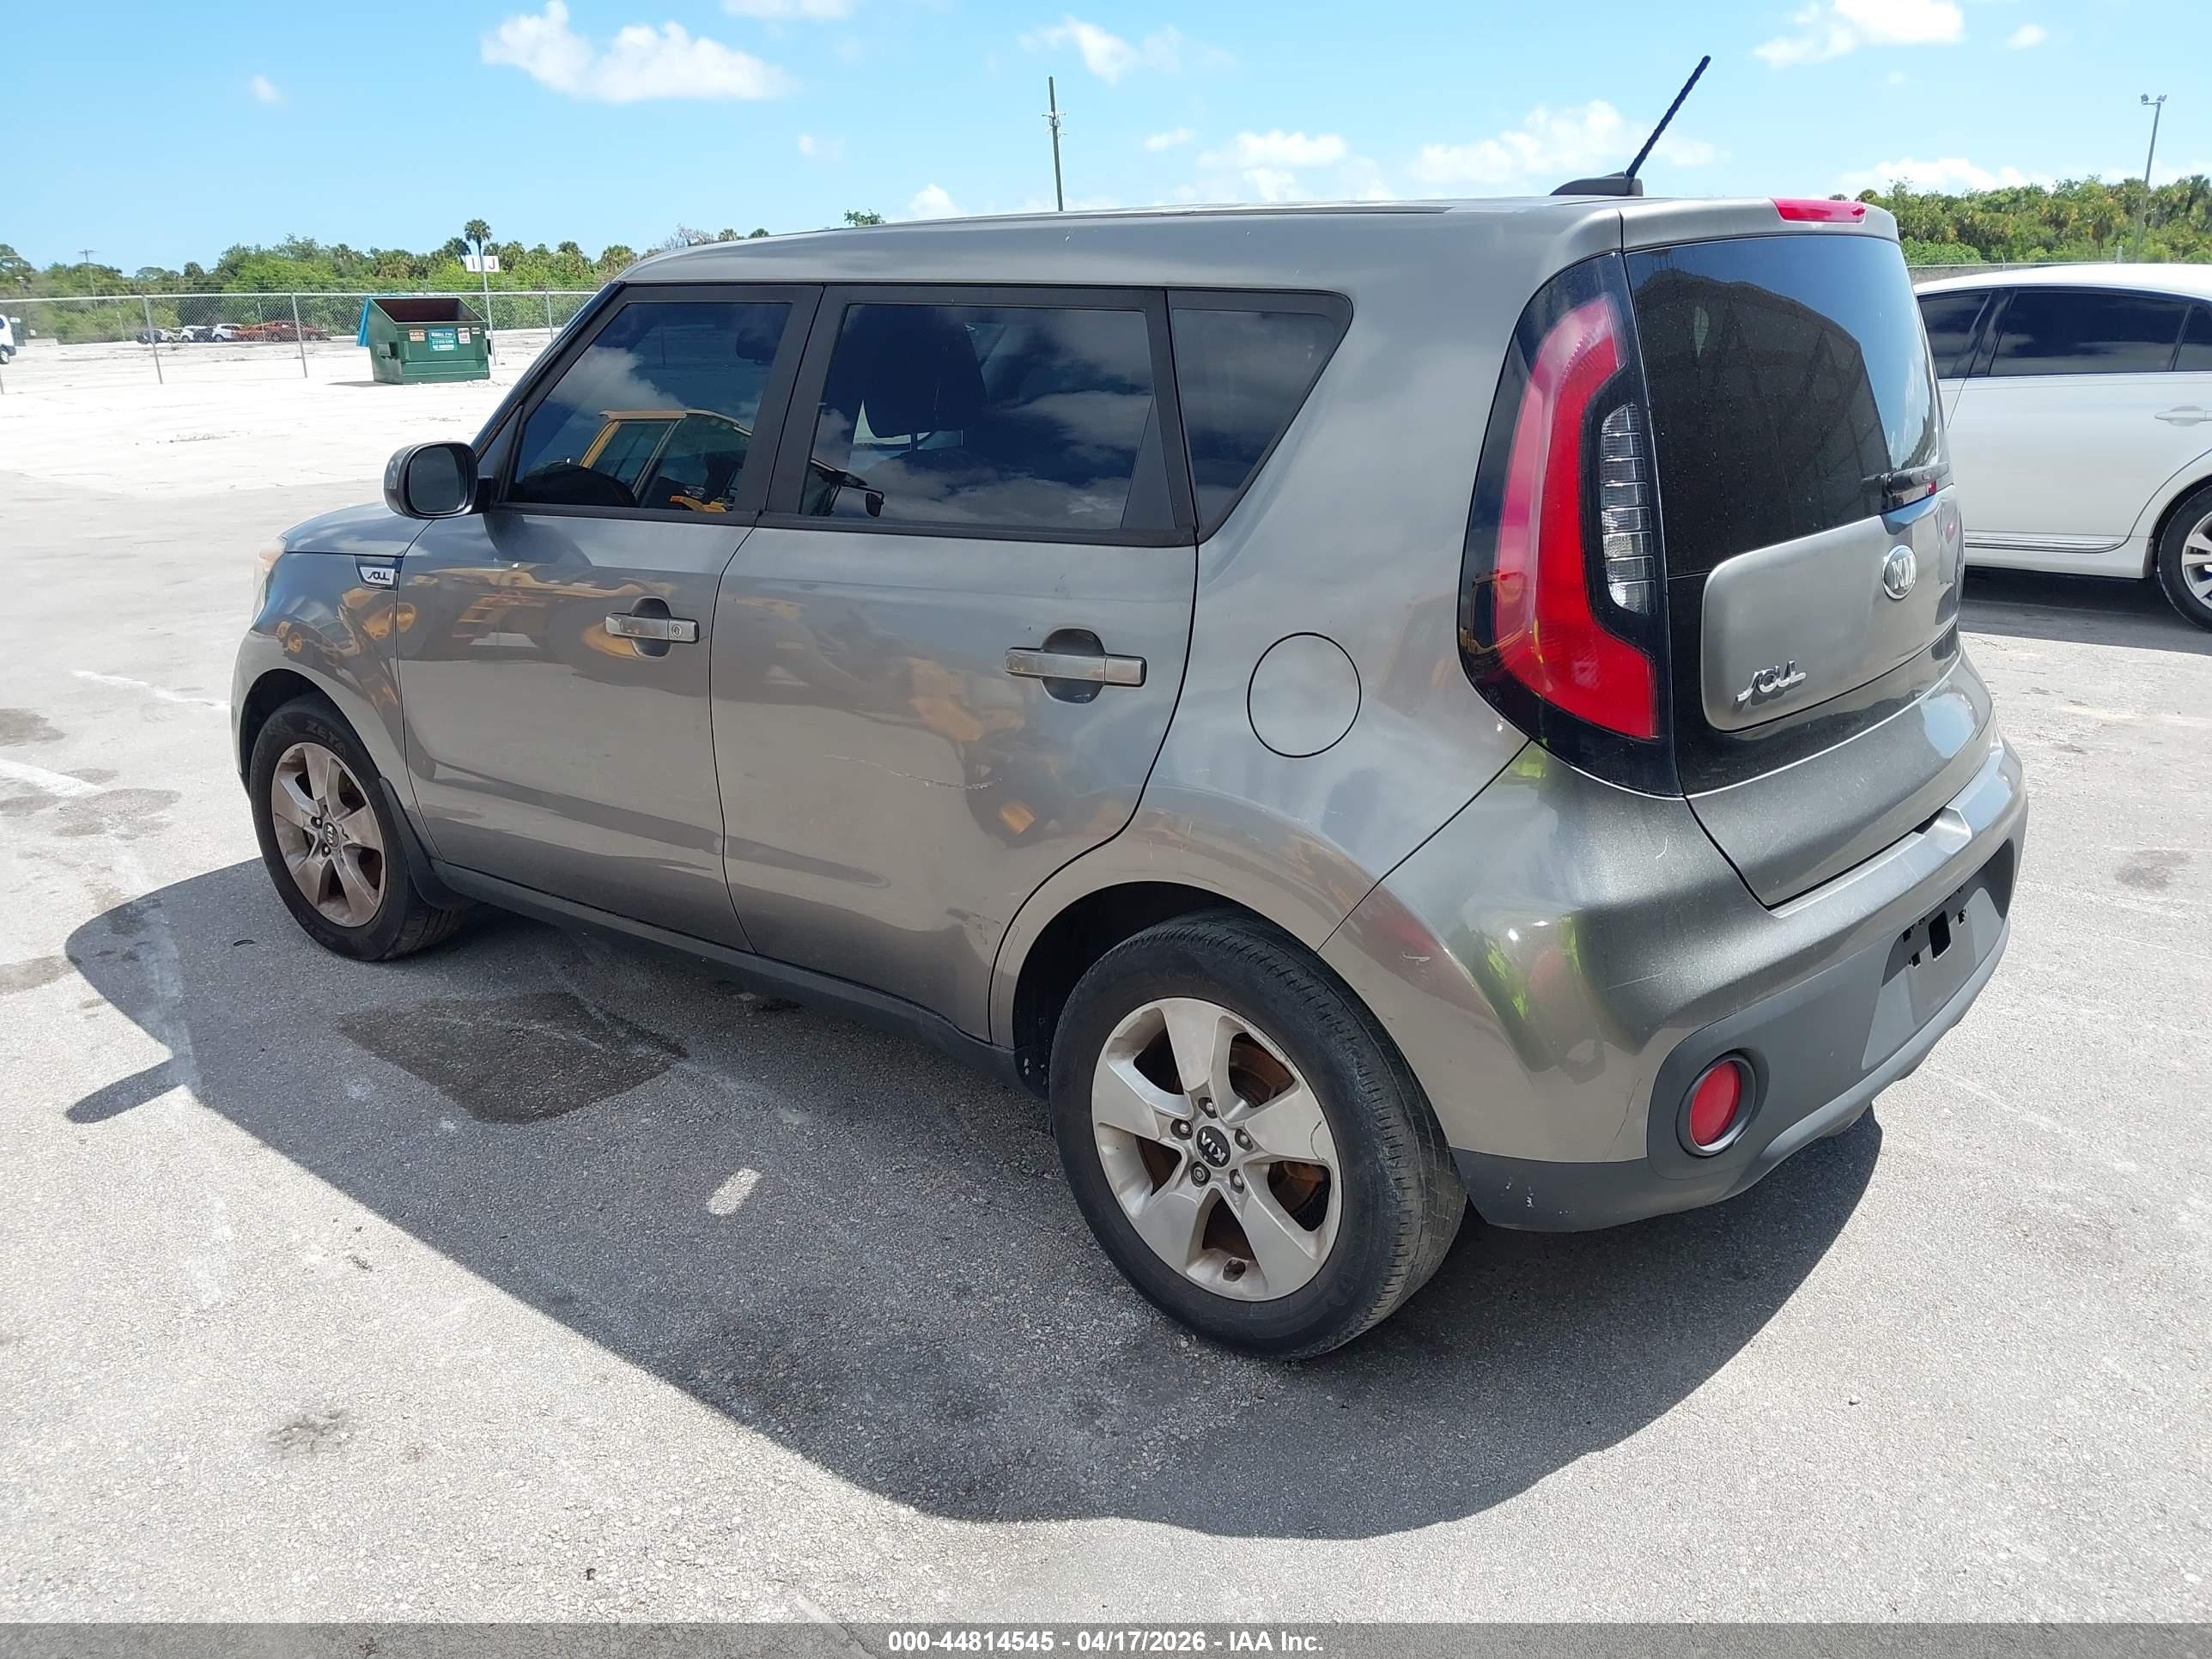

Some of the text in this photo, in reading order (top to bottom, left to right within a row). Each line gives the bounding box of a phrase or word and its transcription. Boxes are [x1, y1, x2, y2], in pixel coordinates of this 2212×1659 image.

[488, 257, 495, 270] J
[1892, 554, 1916, 589] KIA
[1735, 659, 1807, 702] SOUL
[305, 720, 347, 758] ZETA
[1200, 1131, 1227, 1164] KIA
